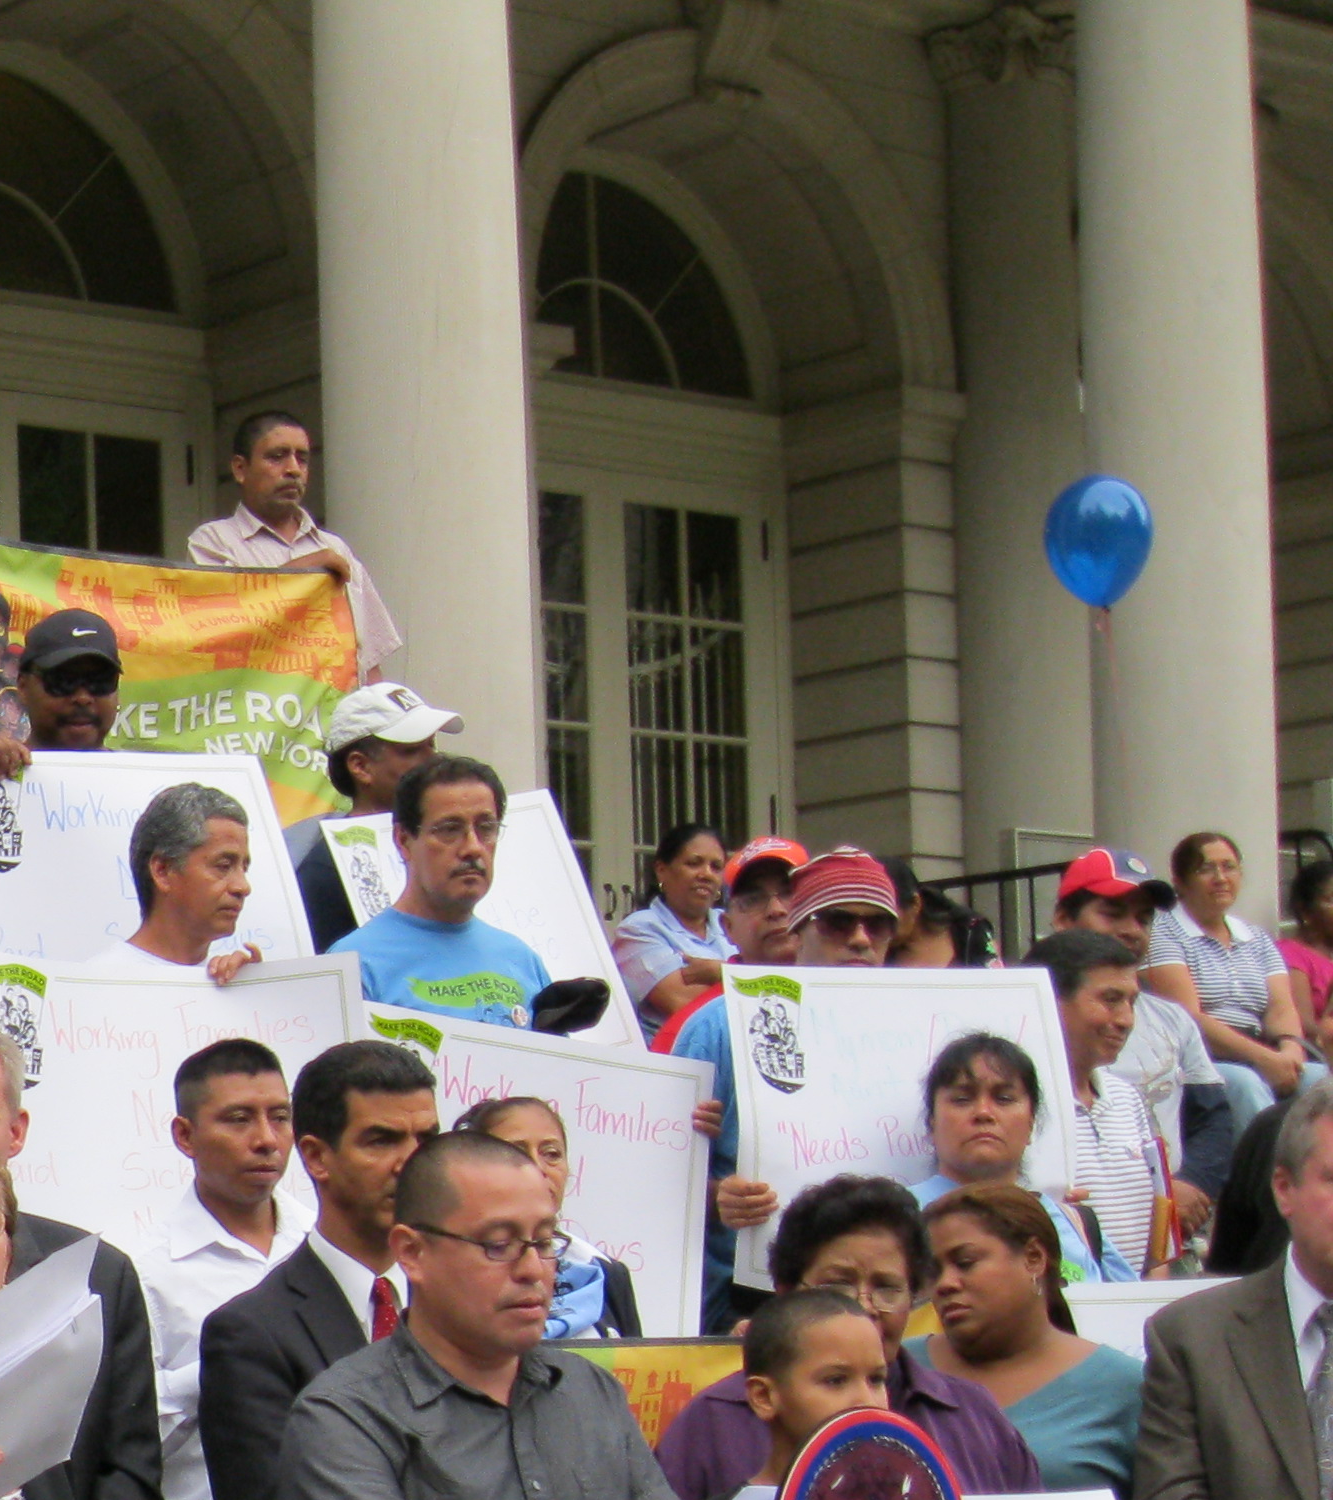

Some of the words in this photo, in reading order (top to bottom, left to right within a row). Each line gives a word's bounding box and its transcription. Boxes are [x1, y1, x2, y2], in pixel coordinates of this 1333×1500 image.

[111, 702, 161, 739] KE
[168, 689, 236, 735] THE
[245, 691, 324, 742] ROA
[204, 731, 275, 757] NEW
[281, 737, 330, 773] YOR
[5, 967, 19, 976] THE
[21, 967, 44, 986] ROAD
[428, 985, 467, 998] MAKE
[468, 977, 491, 992] THE
[493, 978, 522, 998] ROA
[48, 1000, 161, 1080] Working
[378, 1022, 400, 1031] MAKE
[576, 1077, 691, 1151] Families
